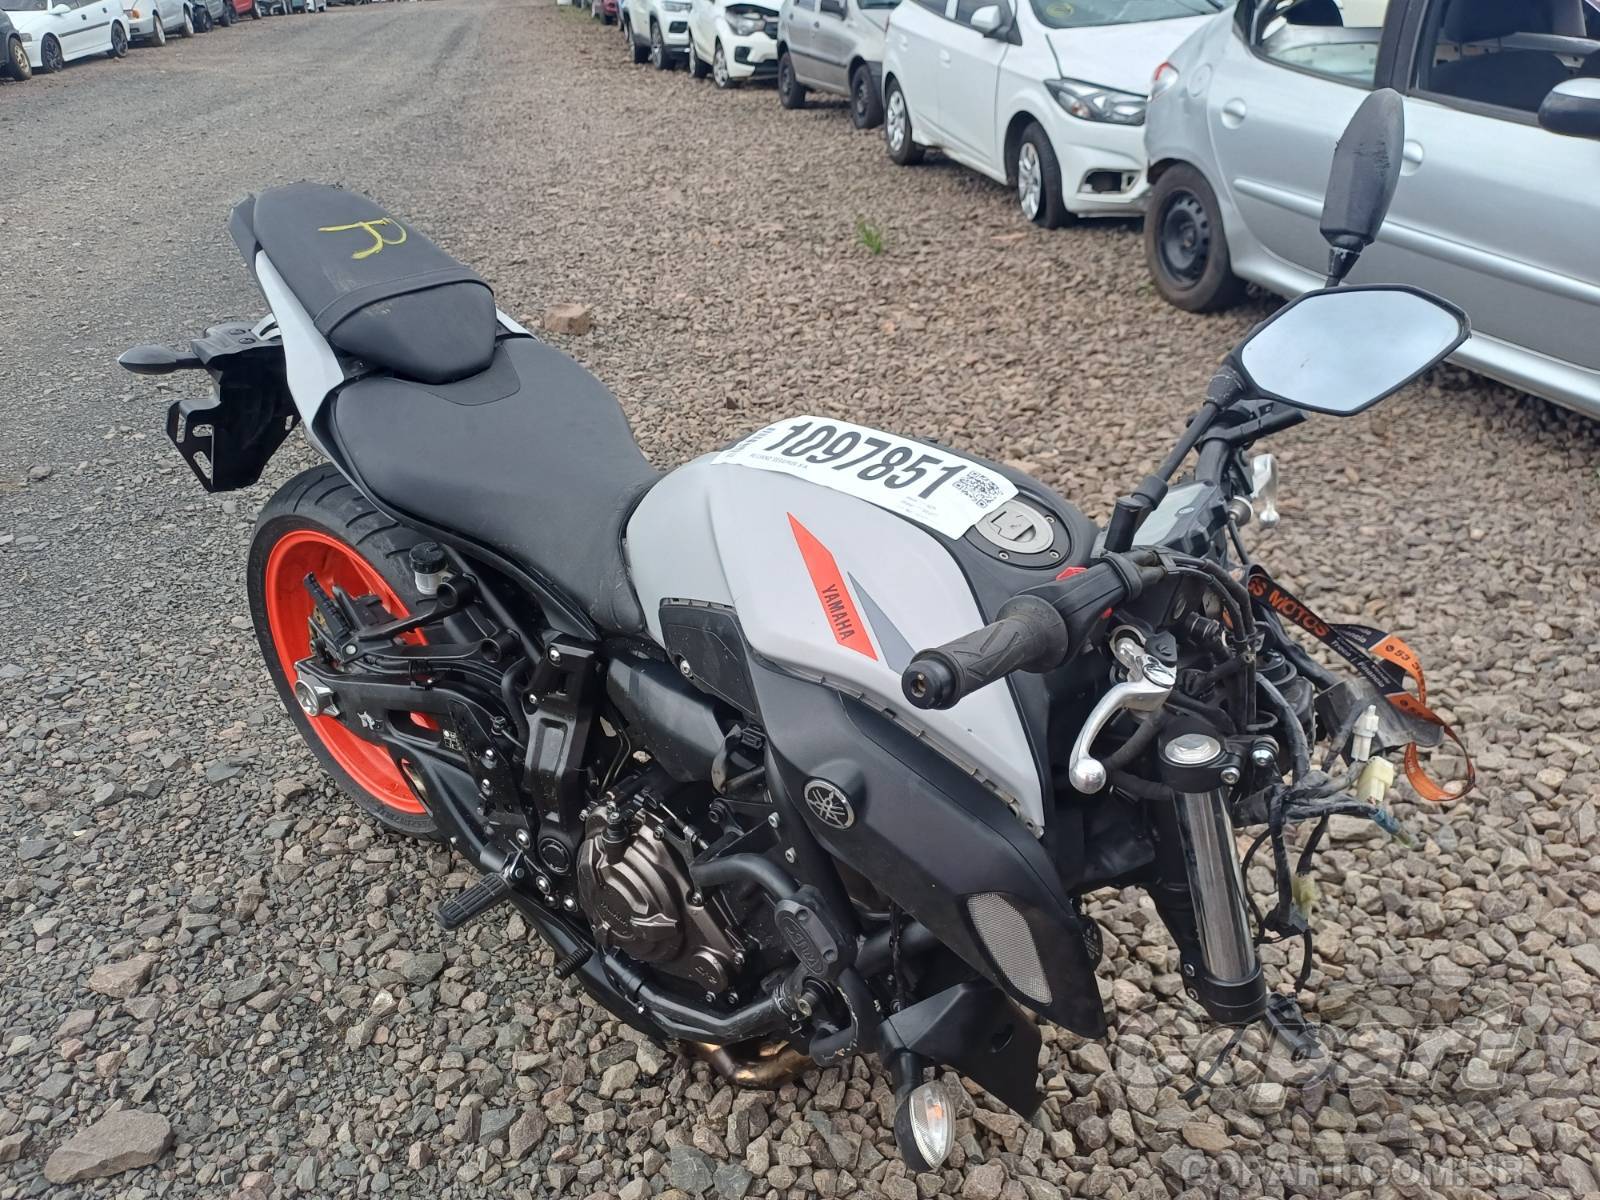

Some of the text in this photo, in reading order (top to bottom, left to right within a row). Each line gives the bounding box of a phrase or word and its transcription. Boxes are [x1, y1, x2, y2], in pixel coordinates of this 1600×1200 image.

[763, 421, 967, 499] 1097851
[821, 583, 856, 641] YAMAHA
[1269, 591, 1329, 637] MOTOS
